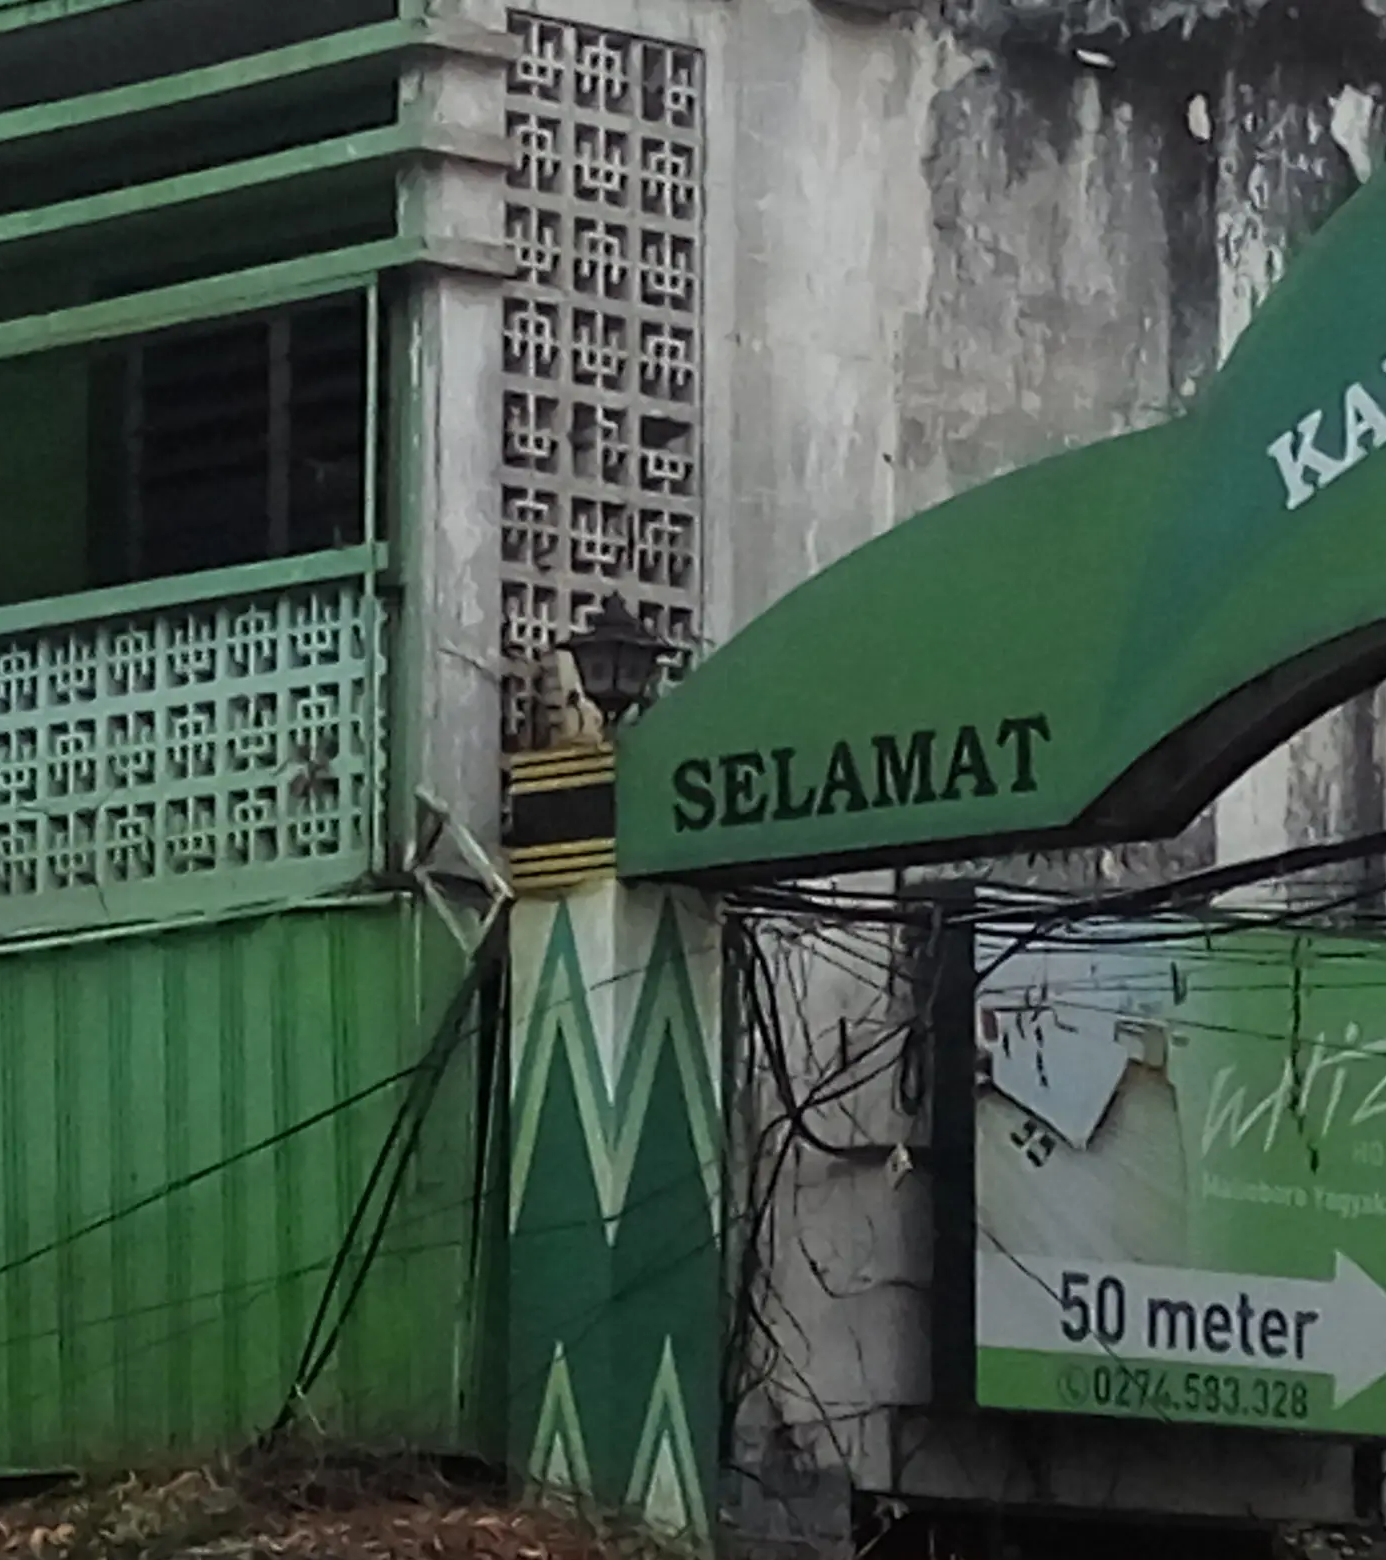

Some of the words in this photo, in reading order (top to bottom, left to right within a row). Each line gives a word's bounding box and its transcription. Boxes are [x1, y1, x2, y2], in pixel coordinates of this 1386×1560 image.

[672, 714, 1051, 832] SELAMAT
[1060, 1269, 1126, 1344] 50
[1146, 1293, 1319, 1360] meter
